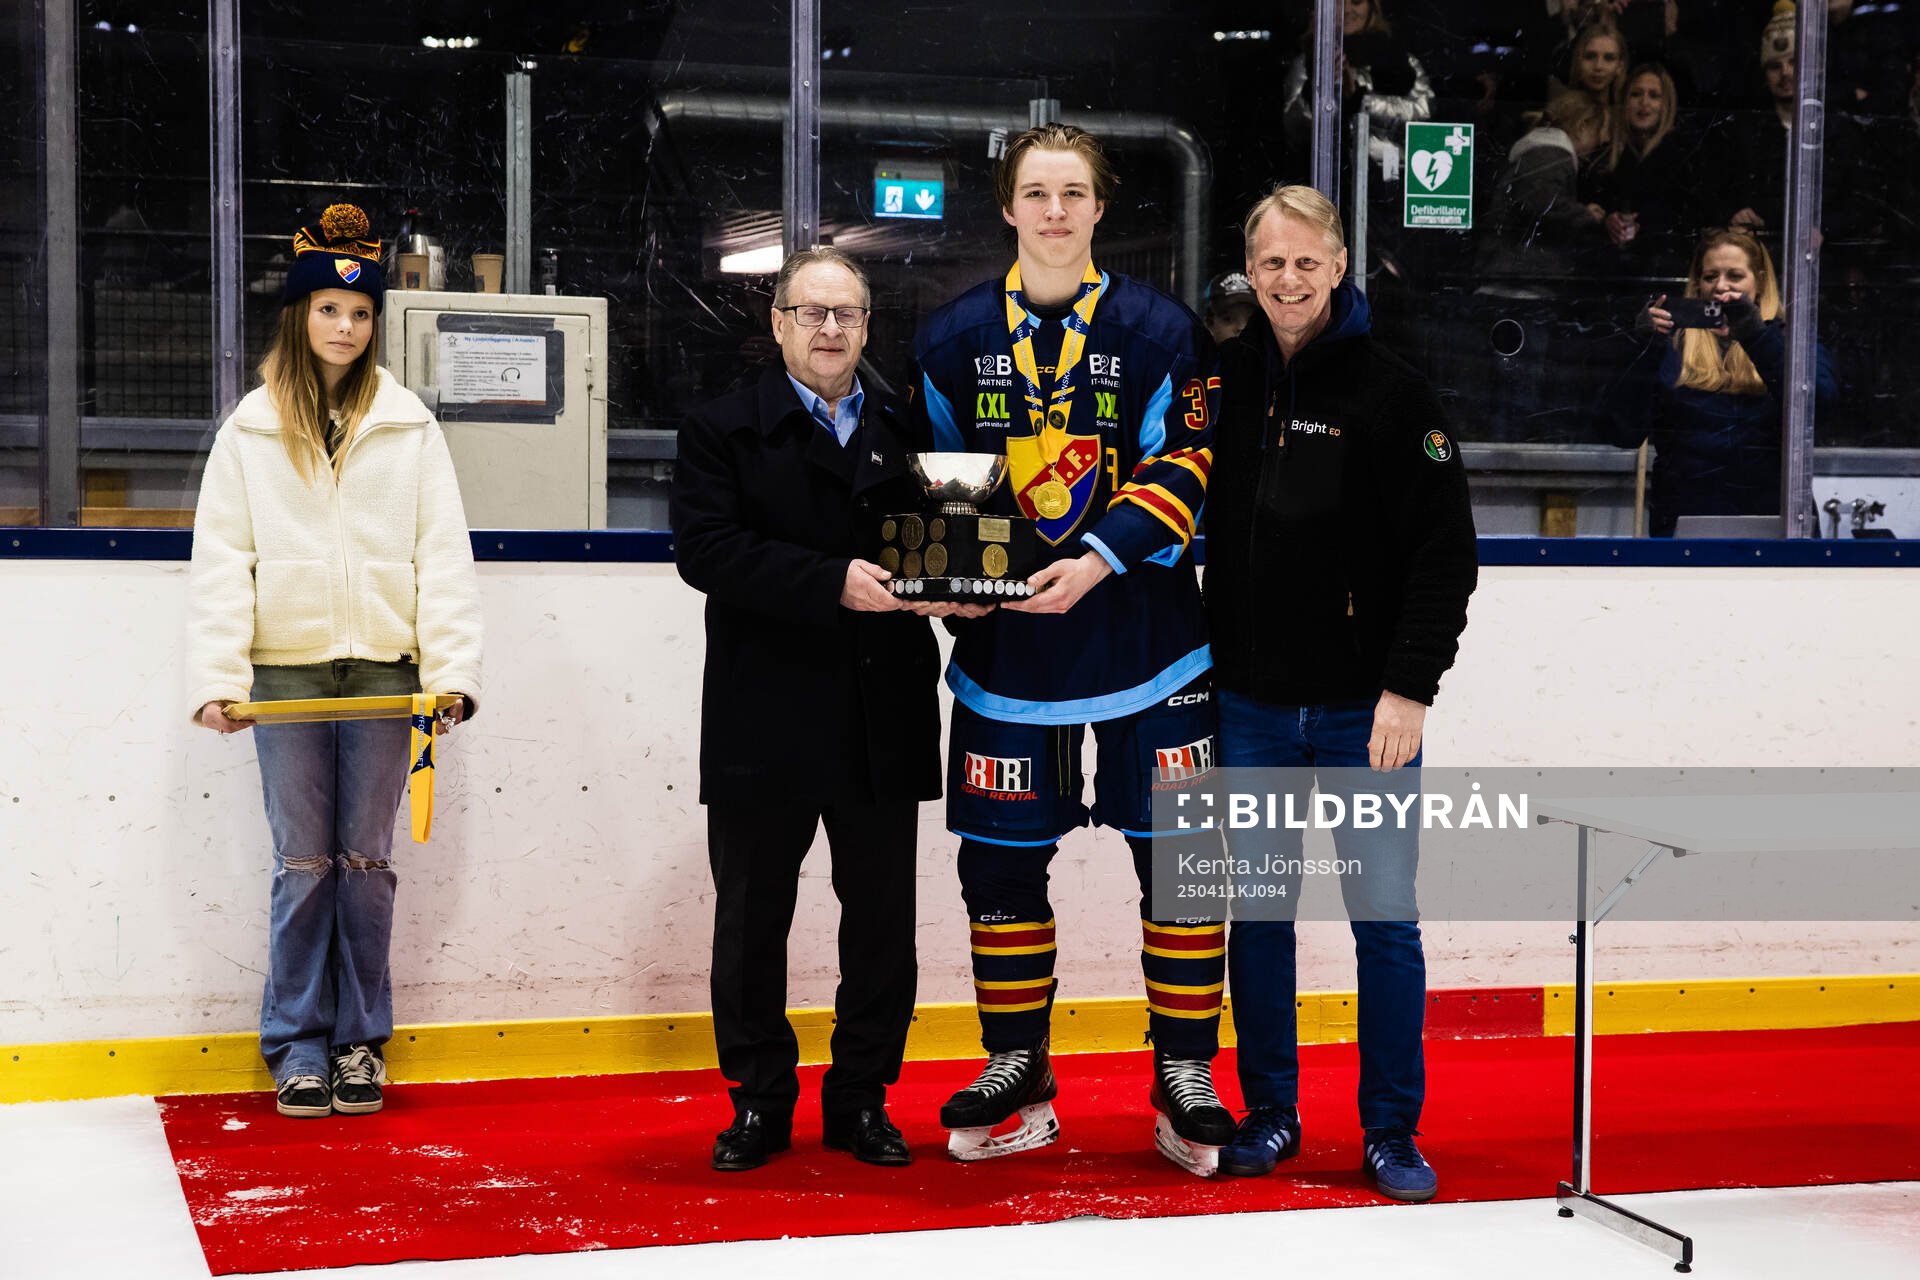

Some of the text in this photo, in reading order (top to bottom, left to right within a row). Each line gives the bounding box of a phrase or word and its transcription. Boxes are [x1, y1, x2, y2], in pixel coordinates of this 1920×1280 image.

[1411, 205, 1467, 216] Defibrillator
[1036, 366, 1057, 374] CC
[1291, 419, 1327, 434] Bright
[1168, 692, 1209, 706] CCM
[989, 791, 1039, 801] RENTAL
[1176, 915, 1211, 924] CCM
